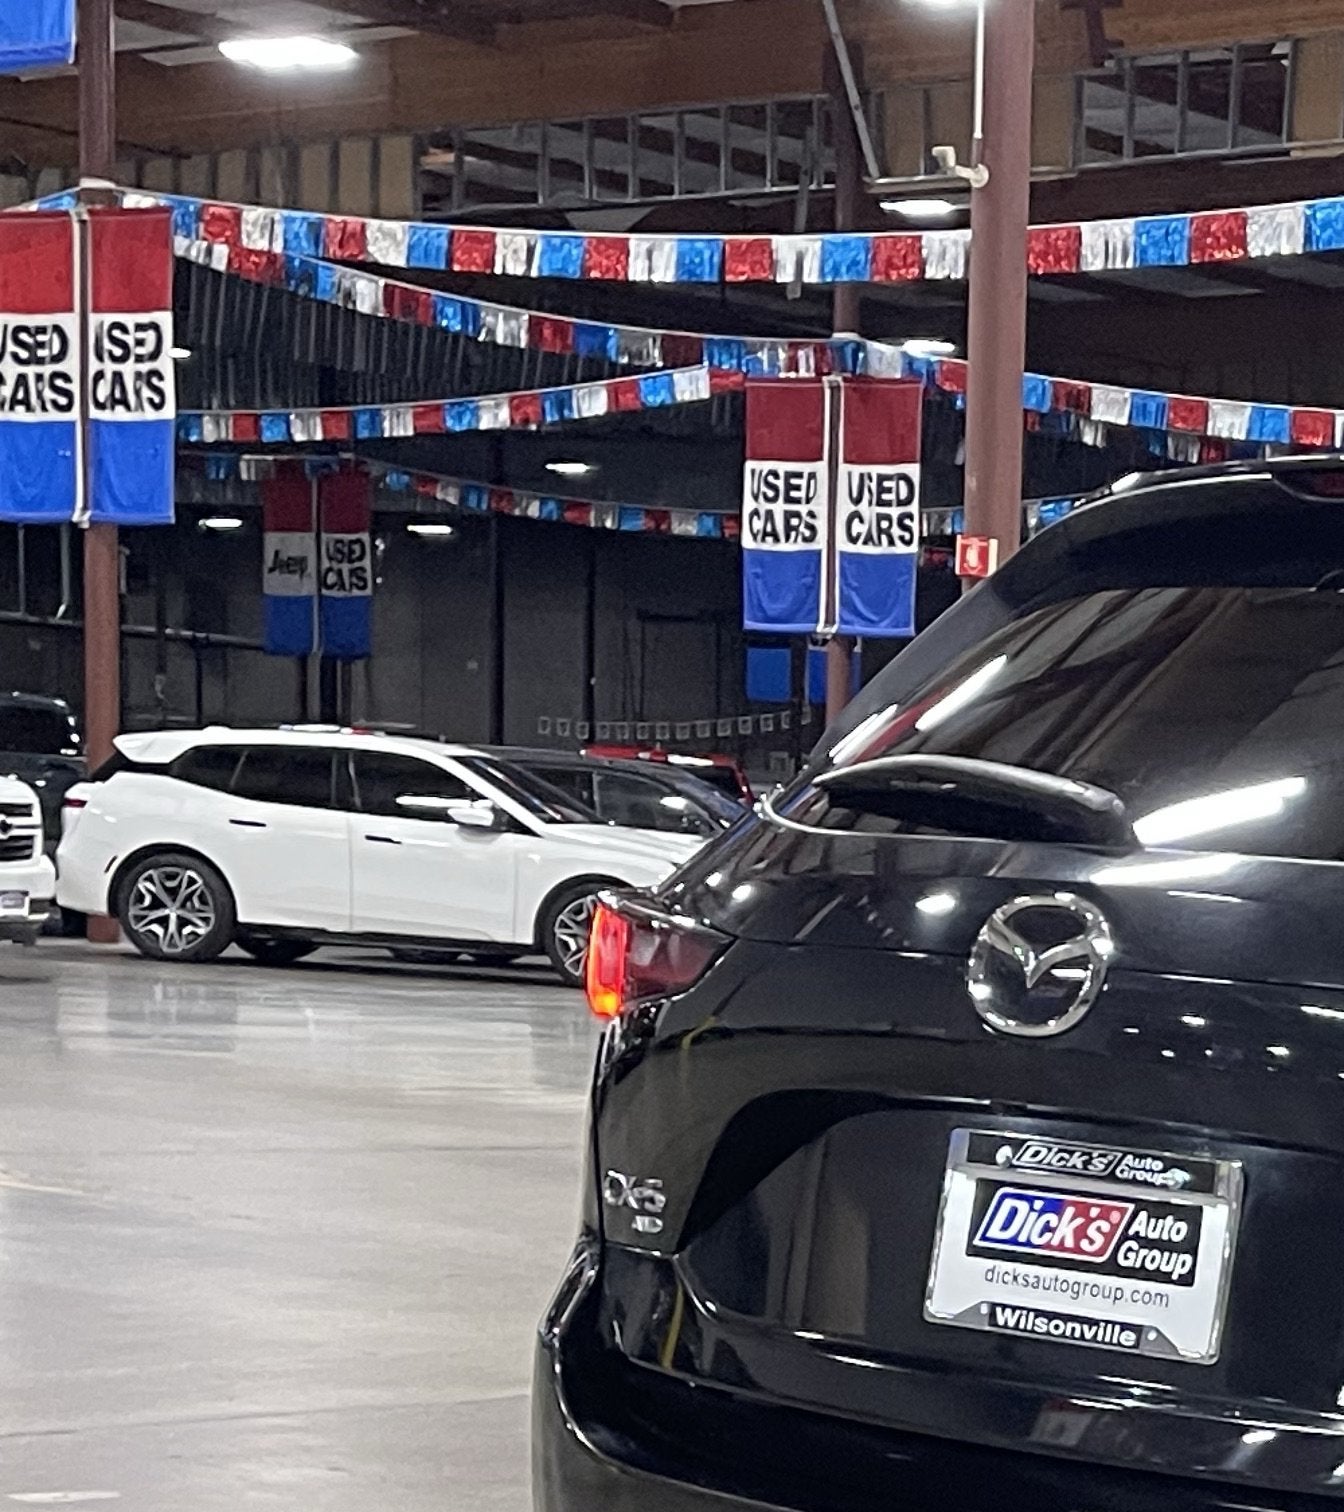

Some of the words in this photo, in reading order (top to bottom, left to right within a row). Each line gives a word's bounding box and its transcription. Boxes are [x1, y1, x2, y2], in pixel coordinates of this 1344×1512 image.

[750, 468, 818, 505] USED
[748, 507, 818, 543] CARS
[1020, 1145, 1113, 1172] Dick's
[1120, 1153, 1164, 1172] Auto
[985, 1196, 1111, 1252] Dick's
[1128, 1210, 1189, 1243] Auto
[1116, 1239, 1194, 1281] Group
[984, 1264, 1170, 1308] dicksautogroup.com
[995, 1306, 1138, 1347] Wilsonville
